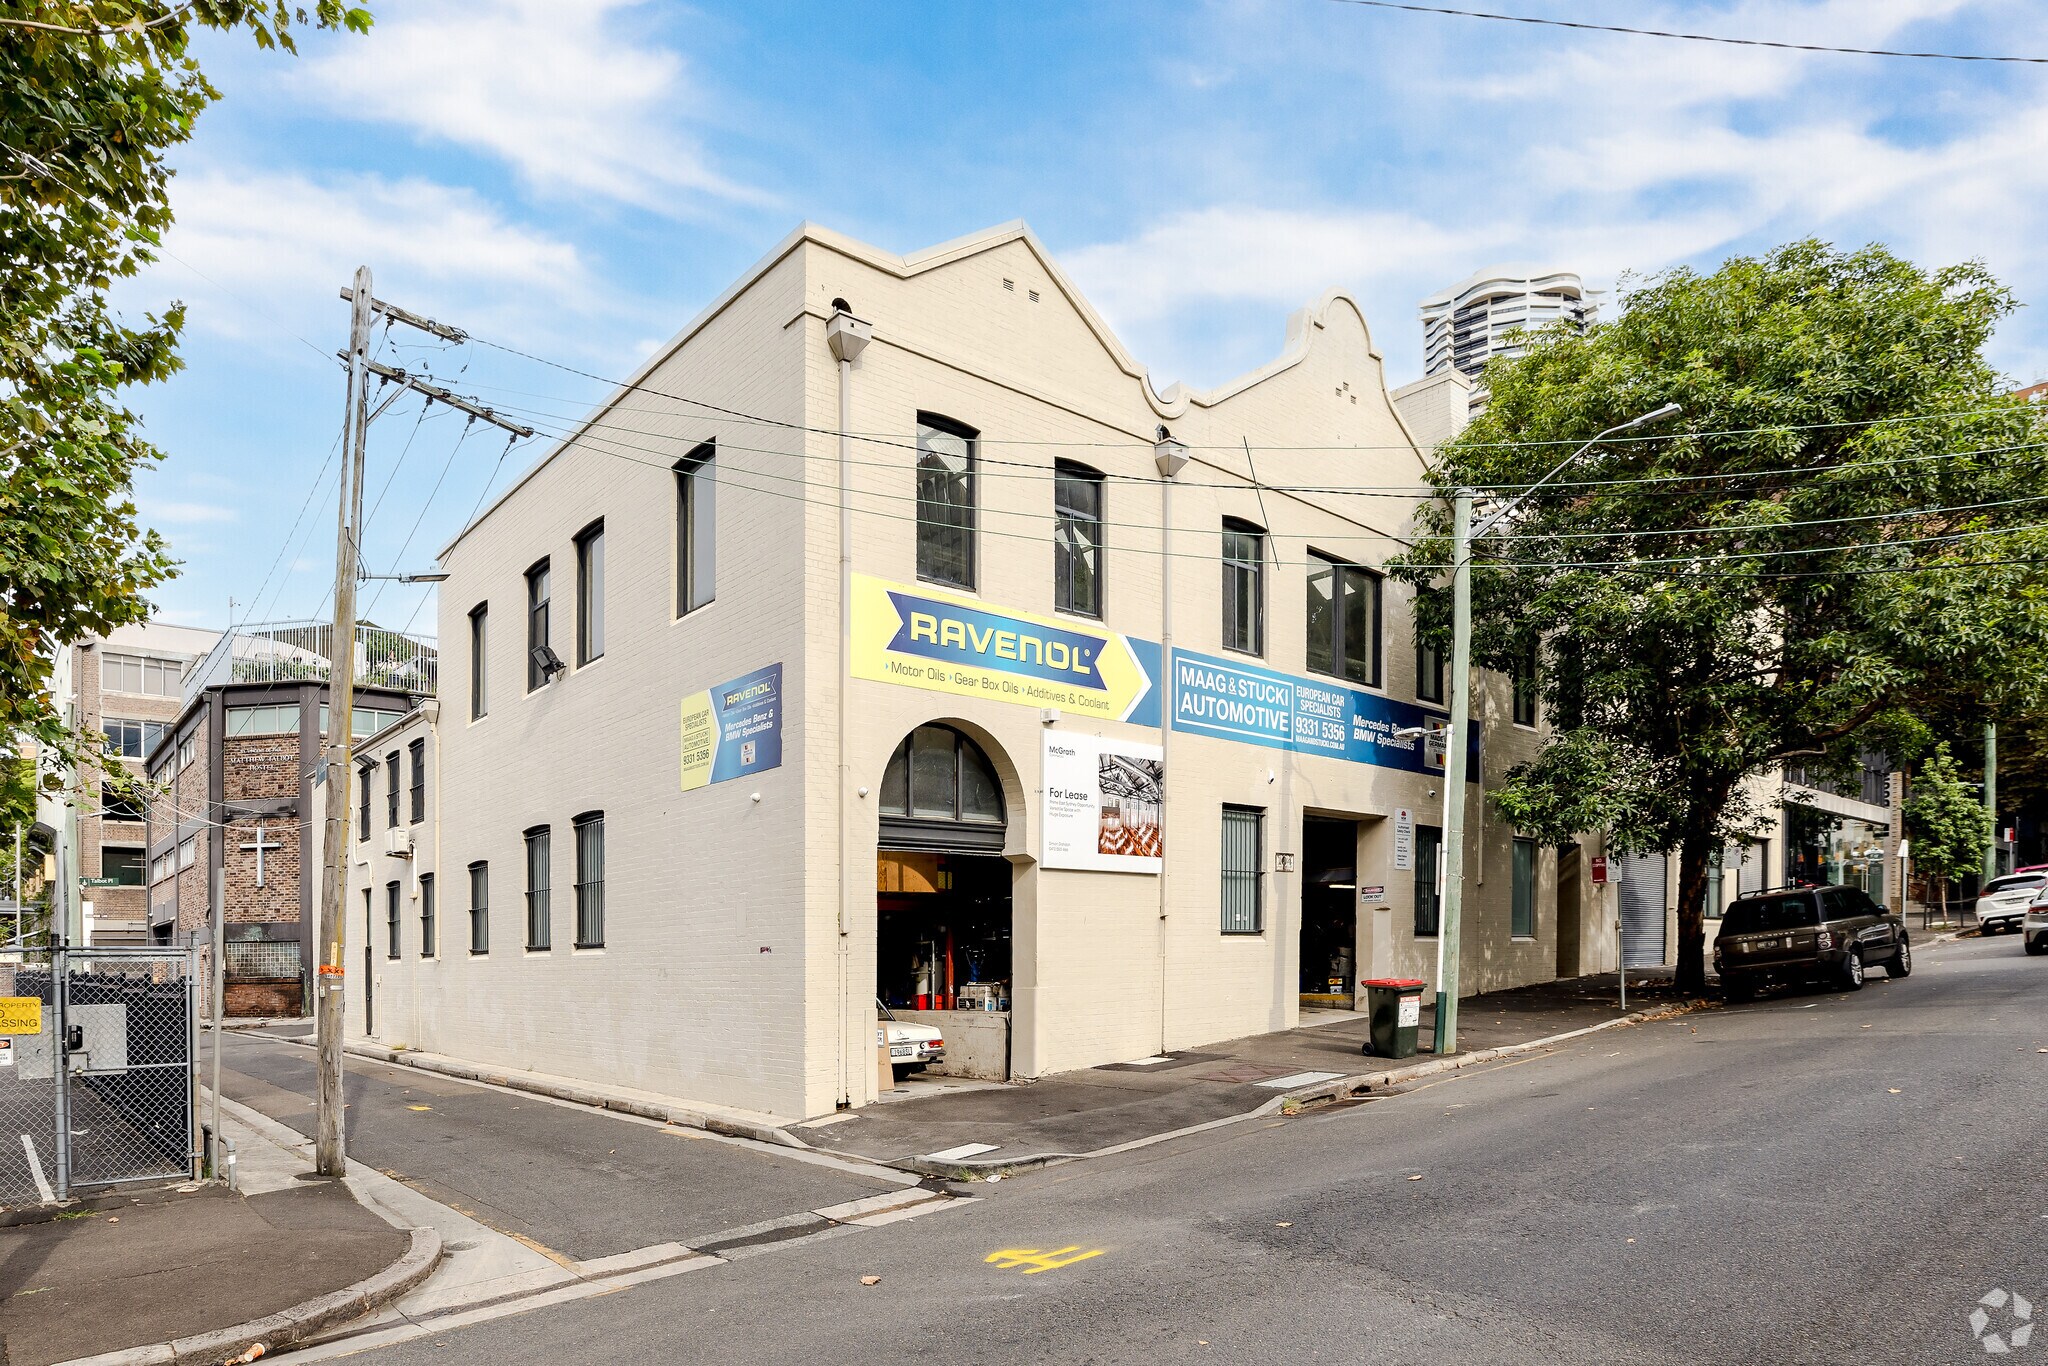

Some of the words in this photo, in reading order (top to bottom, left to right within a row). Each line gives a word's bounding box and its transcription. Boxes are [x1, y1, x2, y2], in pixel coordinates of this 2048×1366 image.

[910, 611, 1090, 675] RAVENOL
[726, 683, 771, 706] RAVENOL
[891, 661, 924, 677] Motor
[927, 668, 946, 682] Oils
[954, 673, 979, 687] Gear
[982, 677, 999, 691] Box
[1002, 681, 1019, 694] Oils
[1027, 686, 1066, 703] Additives
[1068, 693, 1076, 704] &
[1079, 695, 1110, 710] Coolant
[1181, 666, 1227, 693] MAAG
[1228, 677, 1238, 695] &
[1238, 679, 1289, 706] STUCKI
[1296, 685, 1331, 704] EUROPEAN
[1331, 693, 1345, 707] CAR
[683, 712, 701, 724] EUROPEAN
[1181, 692, 1289, 732] AUTOMOTIVE
[1300, 700, 1341, 718] SPECIALISTS
[685, 717, 707, 731] SPECIALISTS
[725, 718, 752, 732] Mercedes
[753, 713, 767, 723] Benz
[768, 708, 774, 718] &
[1296, 717, 1319, 737] 9331
[1322, 721, 1345, 742] 5356
[1353, 714, 1389, 733] Mercedes
[725, 729, 742, 741] BMW
[742, 721, 773, 738] Specialists
[1354, 728, 1375, 743] BMW
[1377, 733, 1415, 751] Specialists
[683, 753, 695, 765] 9331
[696, 749, 709, 761] 5356
[1049, 746, 1075, 756] McGrath
[1049, 787, 1063, 798] For
[1064, 789, 1088, 801] Lease
[0, 1019, 37, 1027] SSING
